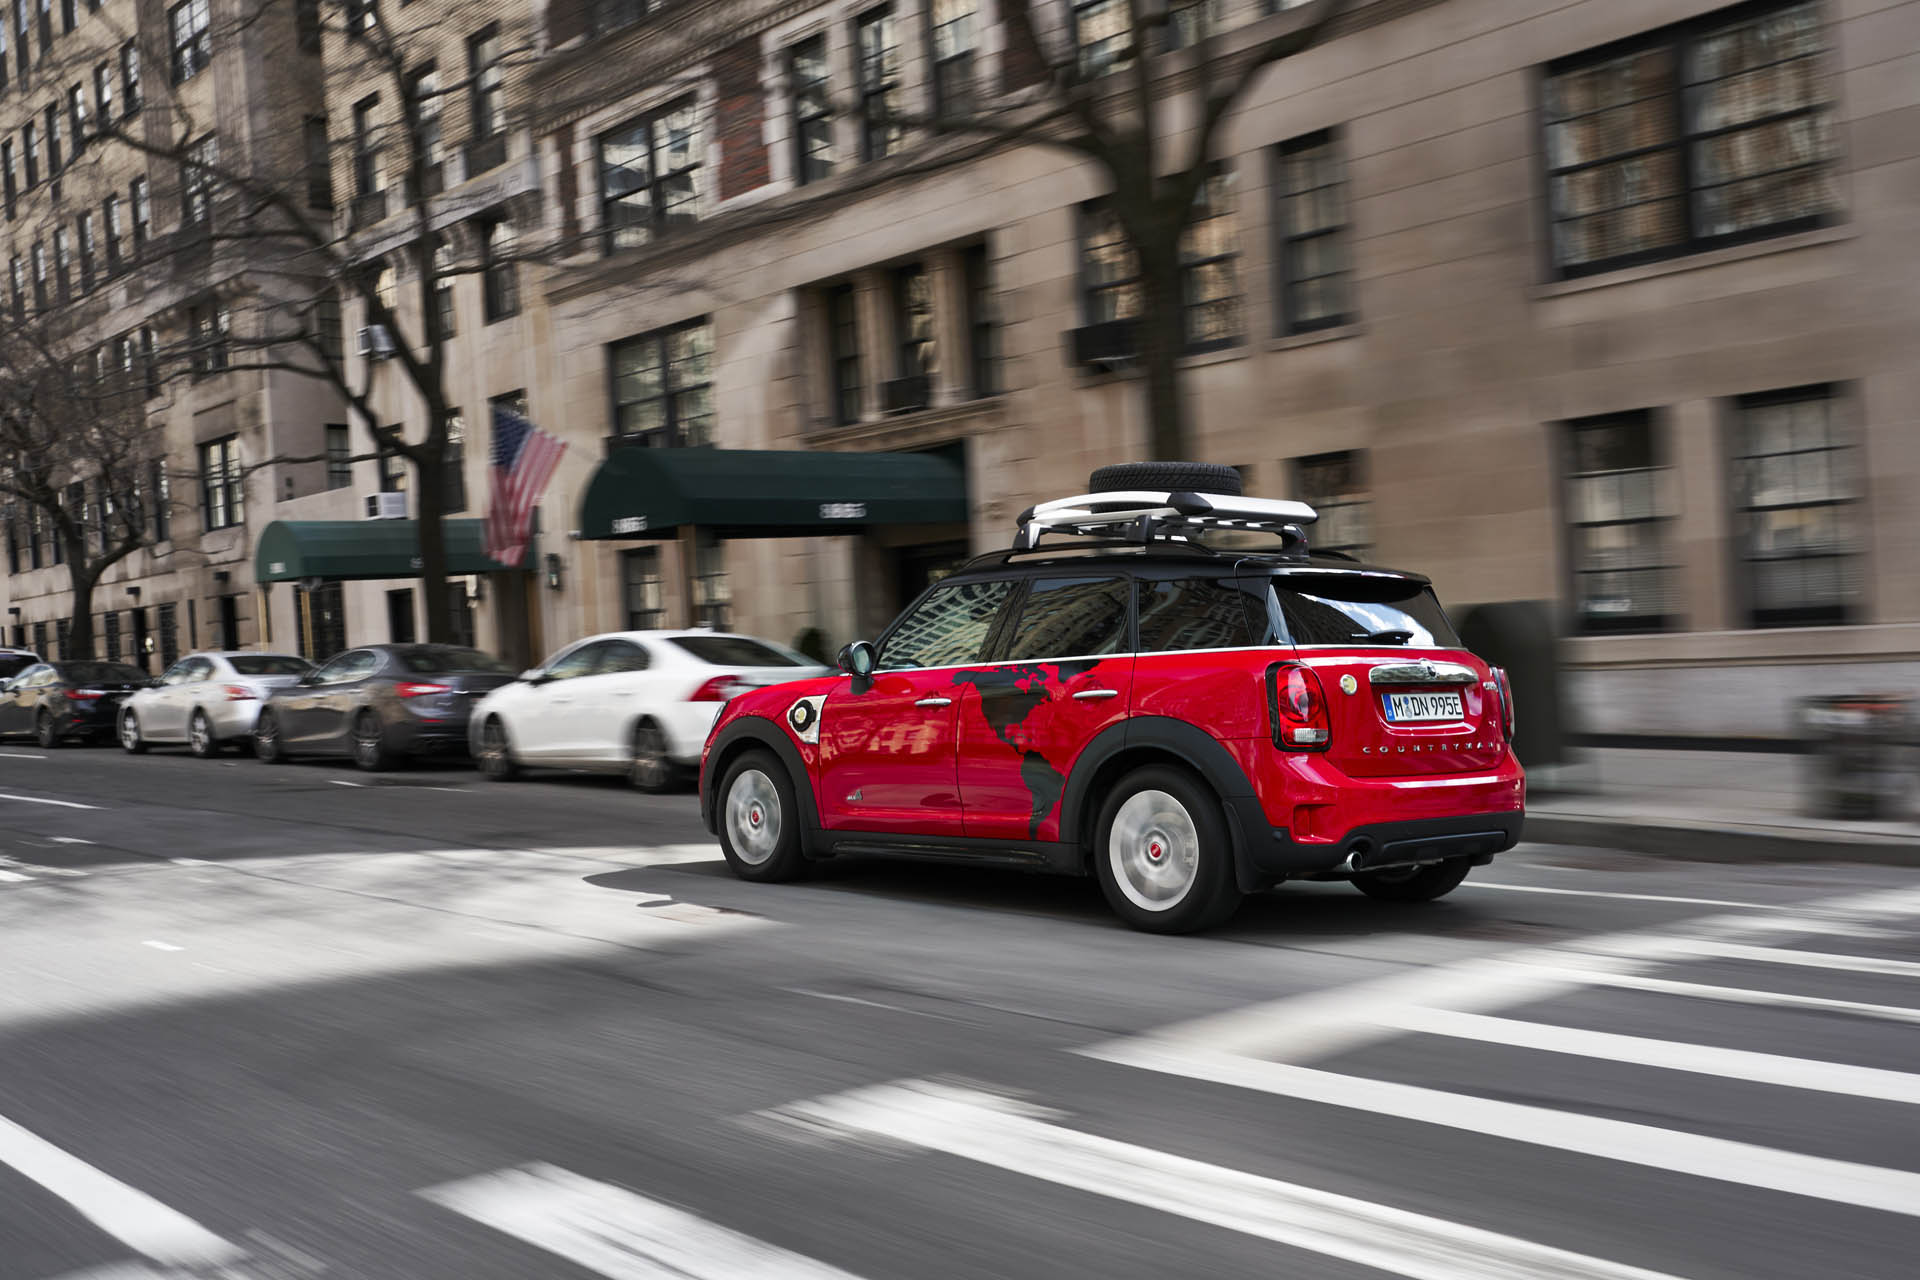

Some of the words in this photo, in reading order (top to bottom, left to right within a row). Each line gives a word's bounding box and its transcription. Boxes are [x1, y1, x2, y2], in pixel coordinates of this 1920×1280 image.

[1392, 697, 1404, 717] M
[1410, 697, 1430, 716] DN
[1430, 696, 1462, 716] 995E
[1362, 742, 1493, 754] COUNTRYMAN
